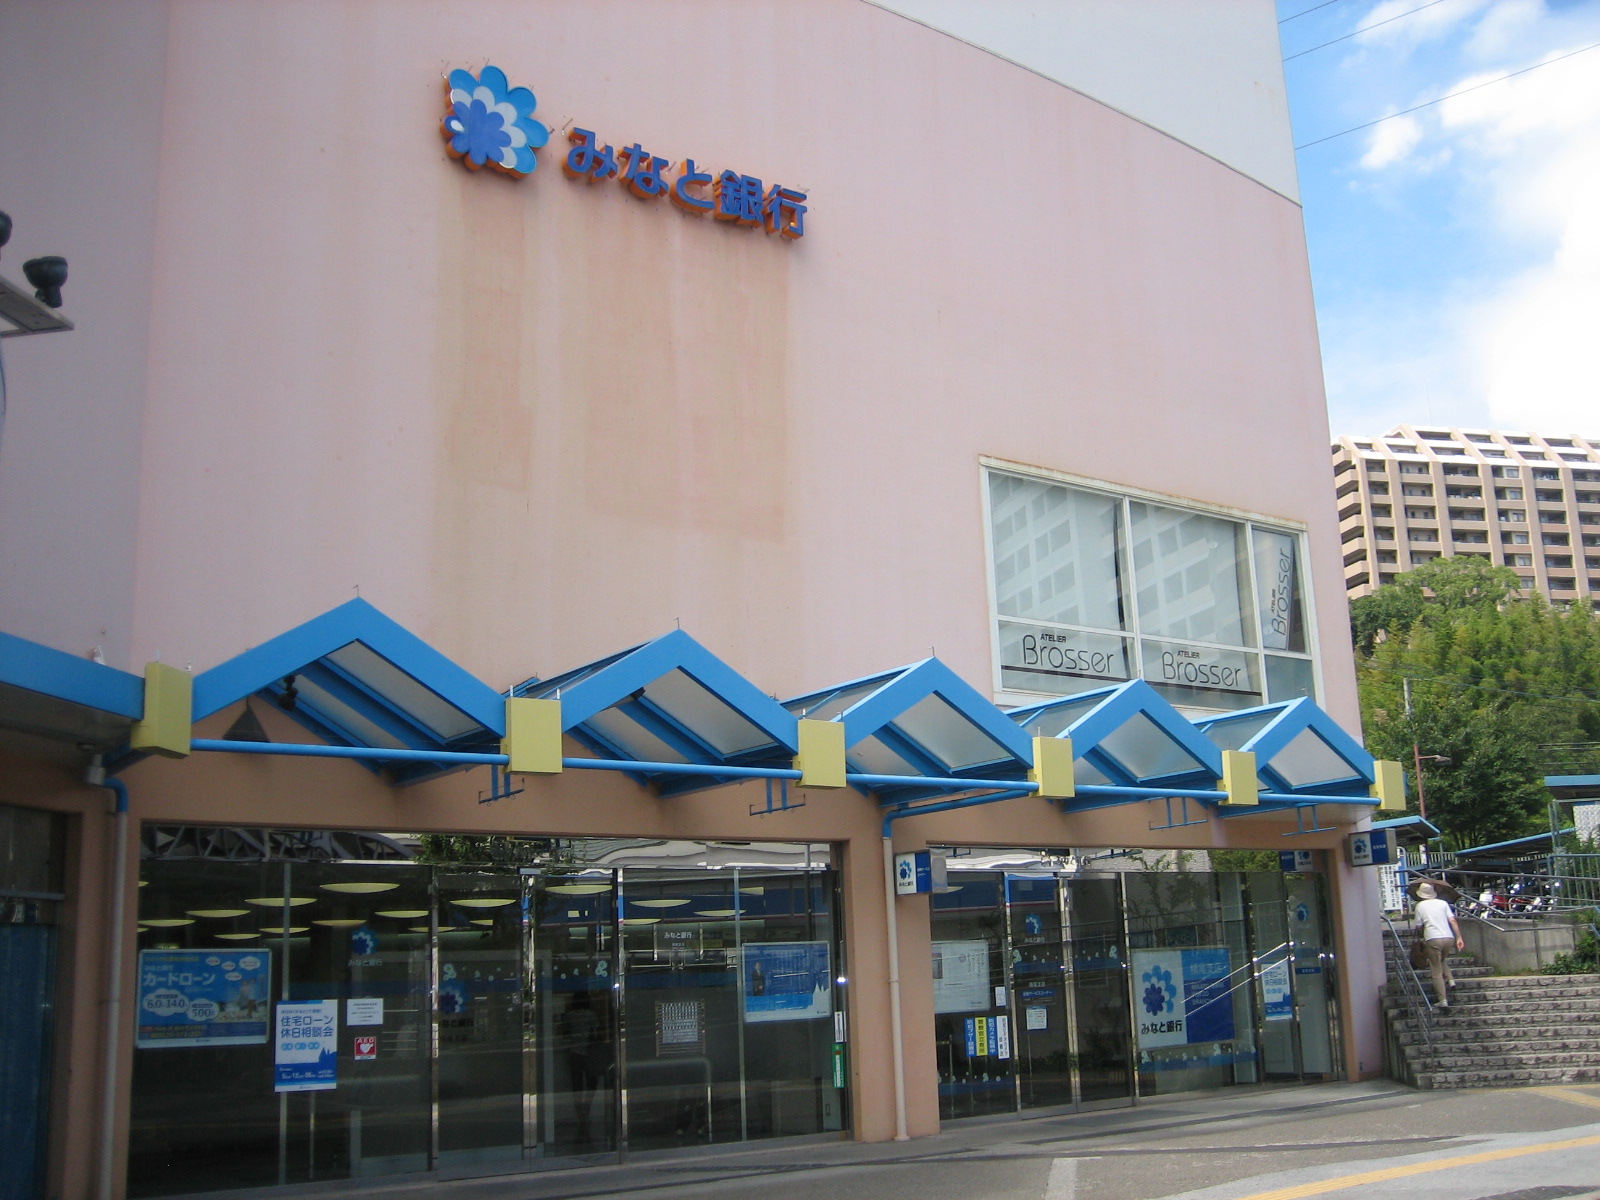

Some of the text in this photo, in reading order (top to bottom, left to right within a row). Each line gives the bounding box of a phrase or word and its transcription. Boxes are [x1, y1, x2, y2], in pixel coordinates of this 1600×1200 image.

[565, 126, 808, 240] みなと銀行
[1271, 547, 1291, 636] Brosser
[1040, 633, 1067, 644] ATELIER
[1022, 634, 1114, 674] Brosser
[1177, 650, 1200, 659] ATELIER
[1162, 651, 1241, 687] Brosser
[663, 931, 692, 939] みなと銀行
[143, 971, 216, 986] カードローン
[281, 1015, 334, 1027] 住宅ローン
[1140, 1019, 1183, 1035] みなと銀行
[280, 1026, 334, 1039] 休日相談会
